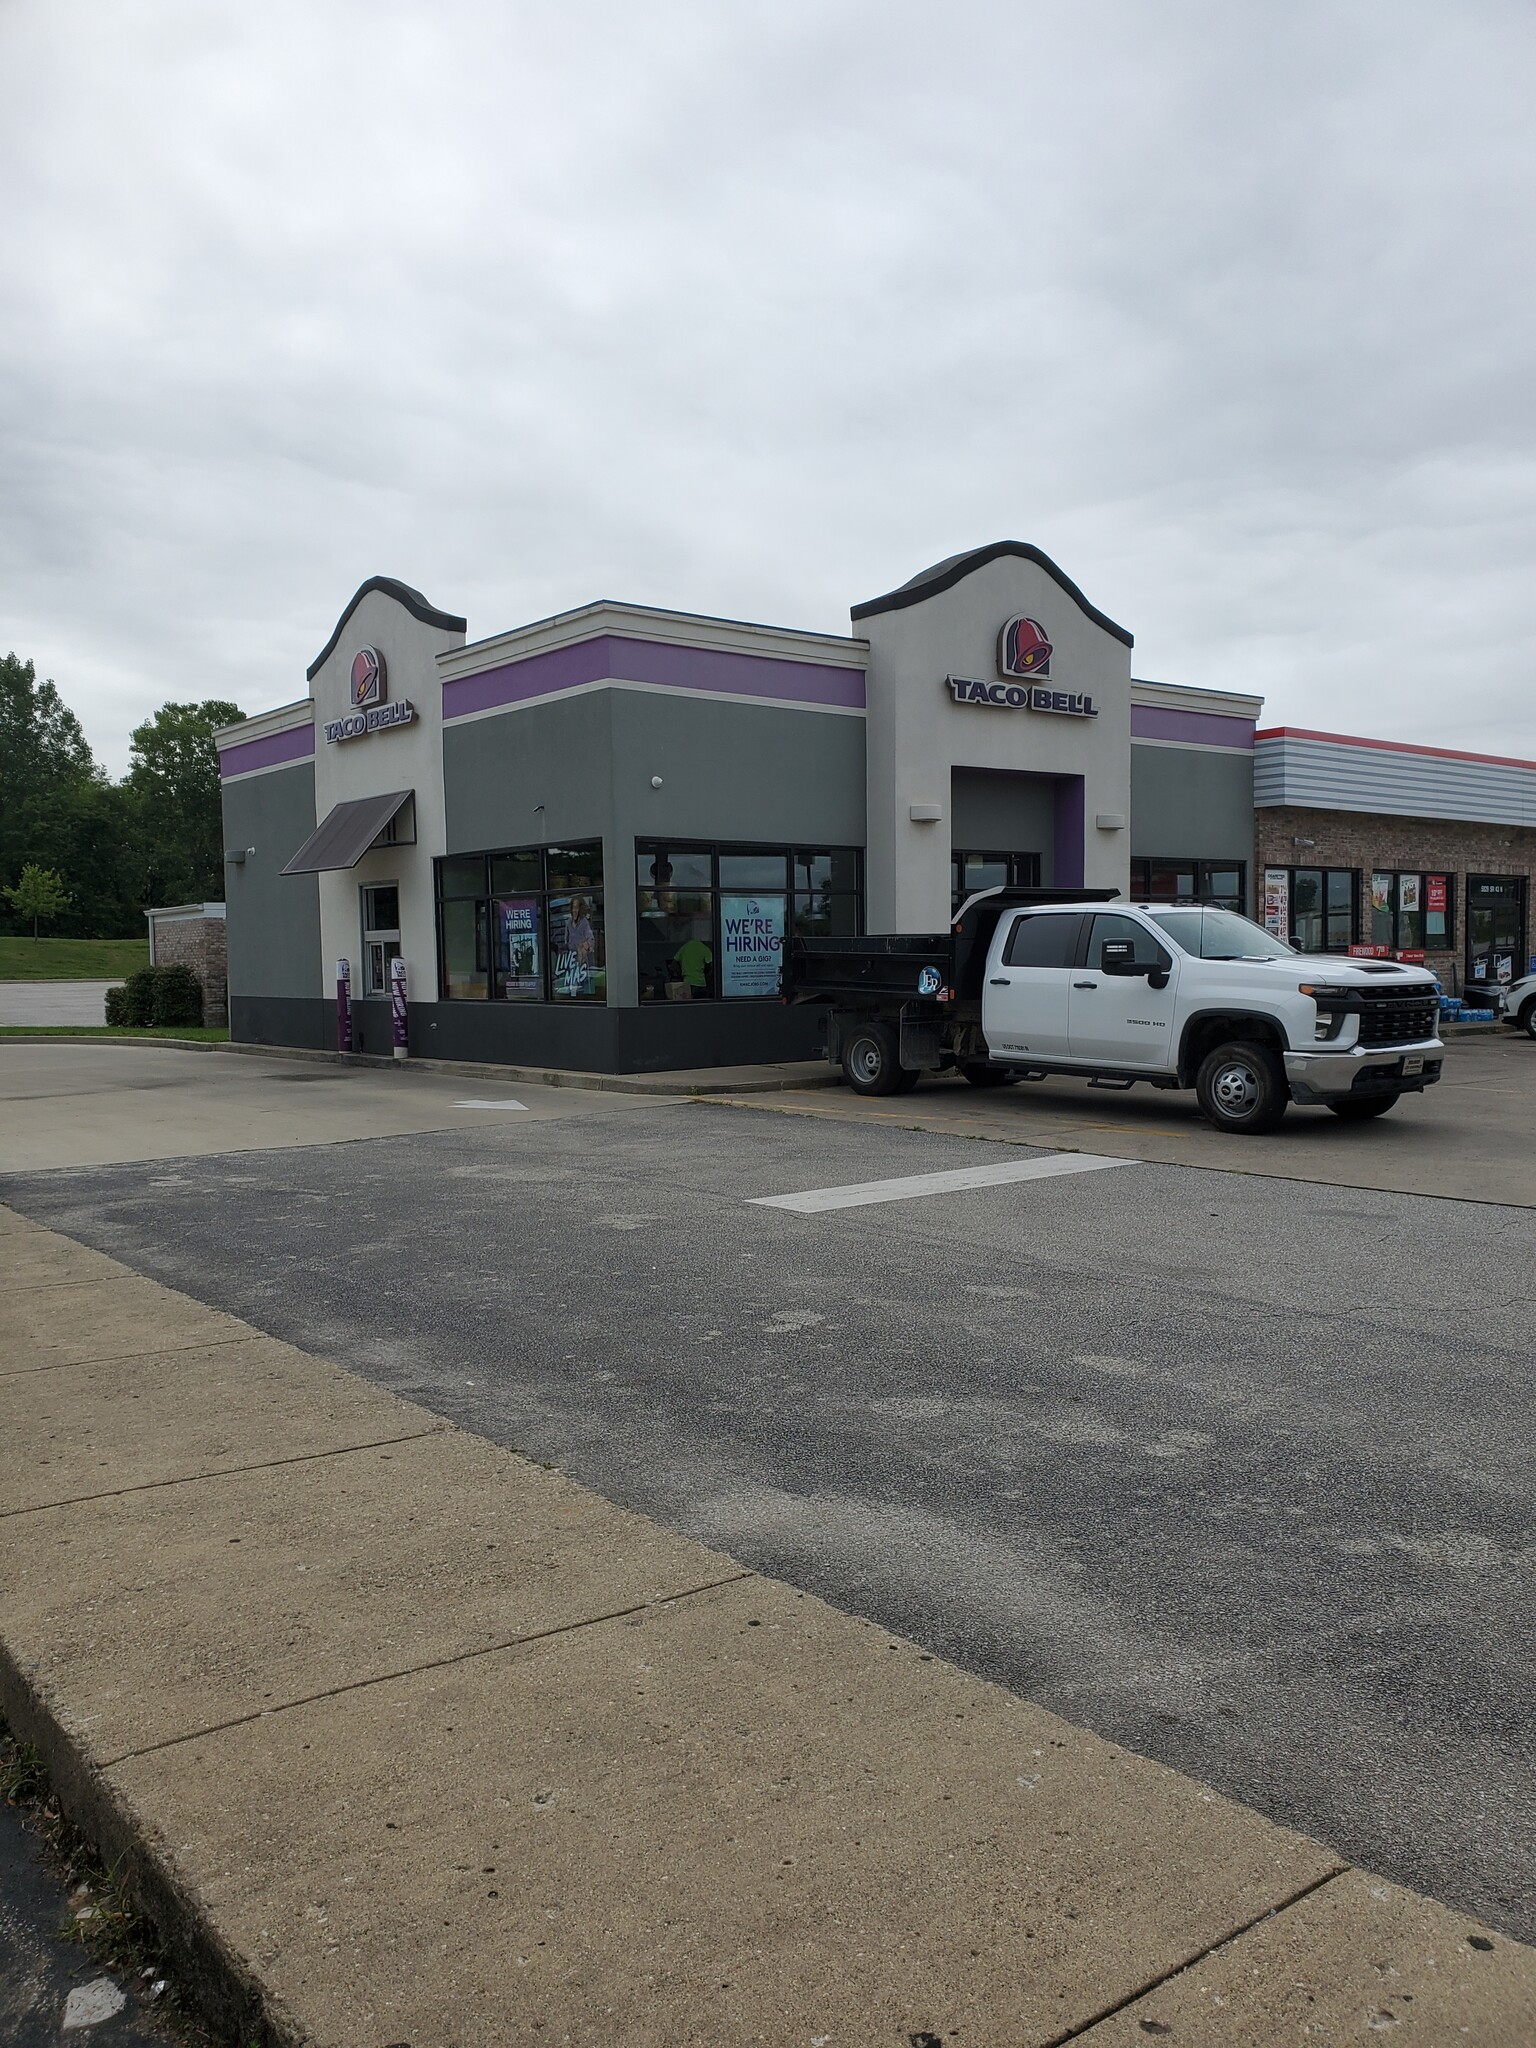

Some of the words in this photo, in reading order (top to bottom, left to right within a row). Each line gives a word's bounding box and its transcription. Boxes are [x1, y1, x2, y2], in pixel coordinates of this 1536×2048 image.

[952, 678, 1027, 706] TACO
[1033, 688, 1099, 716] BELL
[324, 715, 366, 742] TACO
[367, 702, 412, 731] BELL
[505, 909, 531, 920] WE'RE
[505, 919, 532, 930] HIRING
[725, 918, 773, 935] WE'RE
[726, 936, 780, 952] HIRING
[554, 950, 577, 976] LIVE
[735, 955, 752, 963] NEED
[758, 955, 772, 963] GIG?
